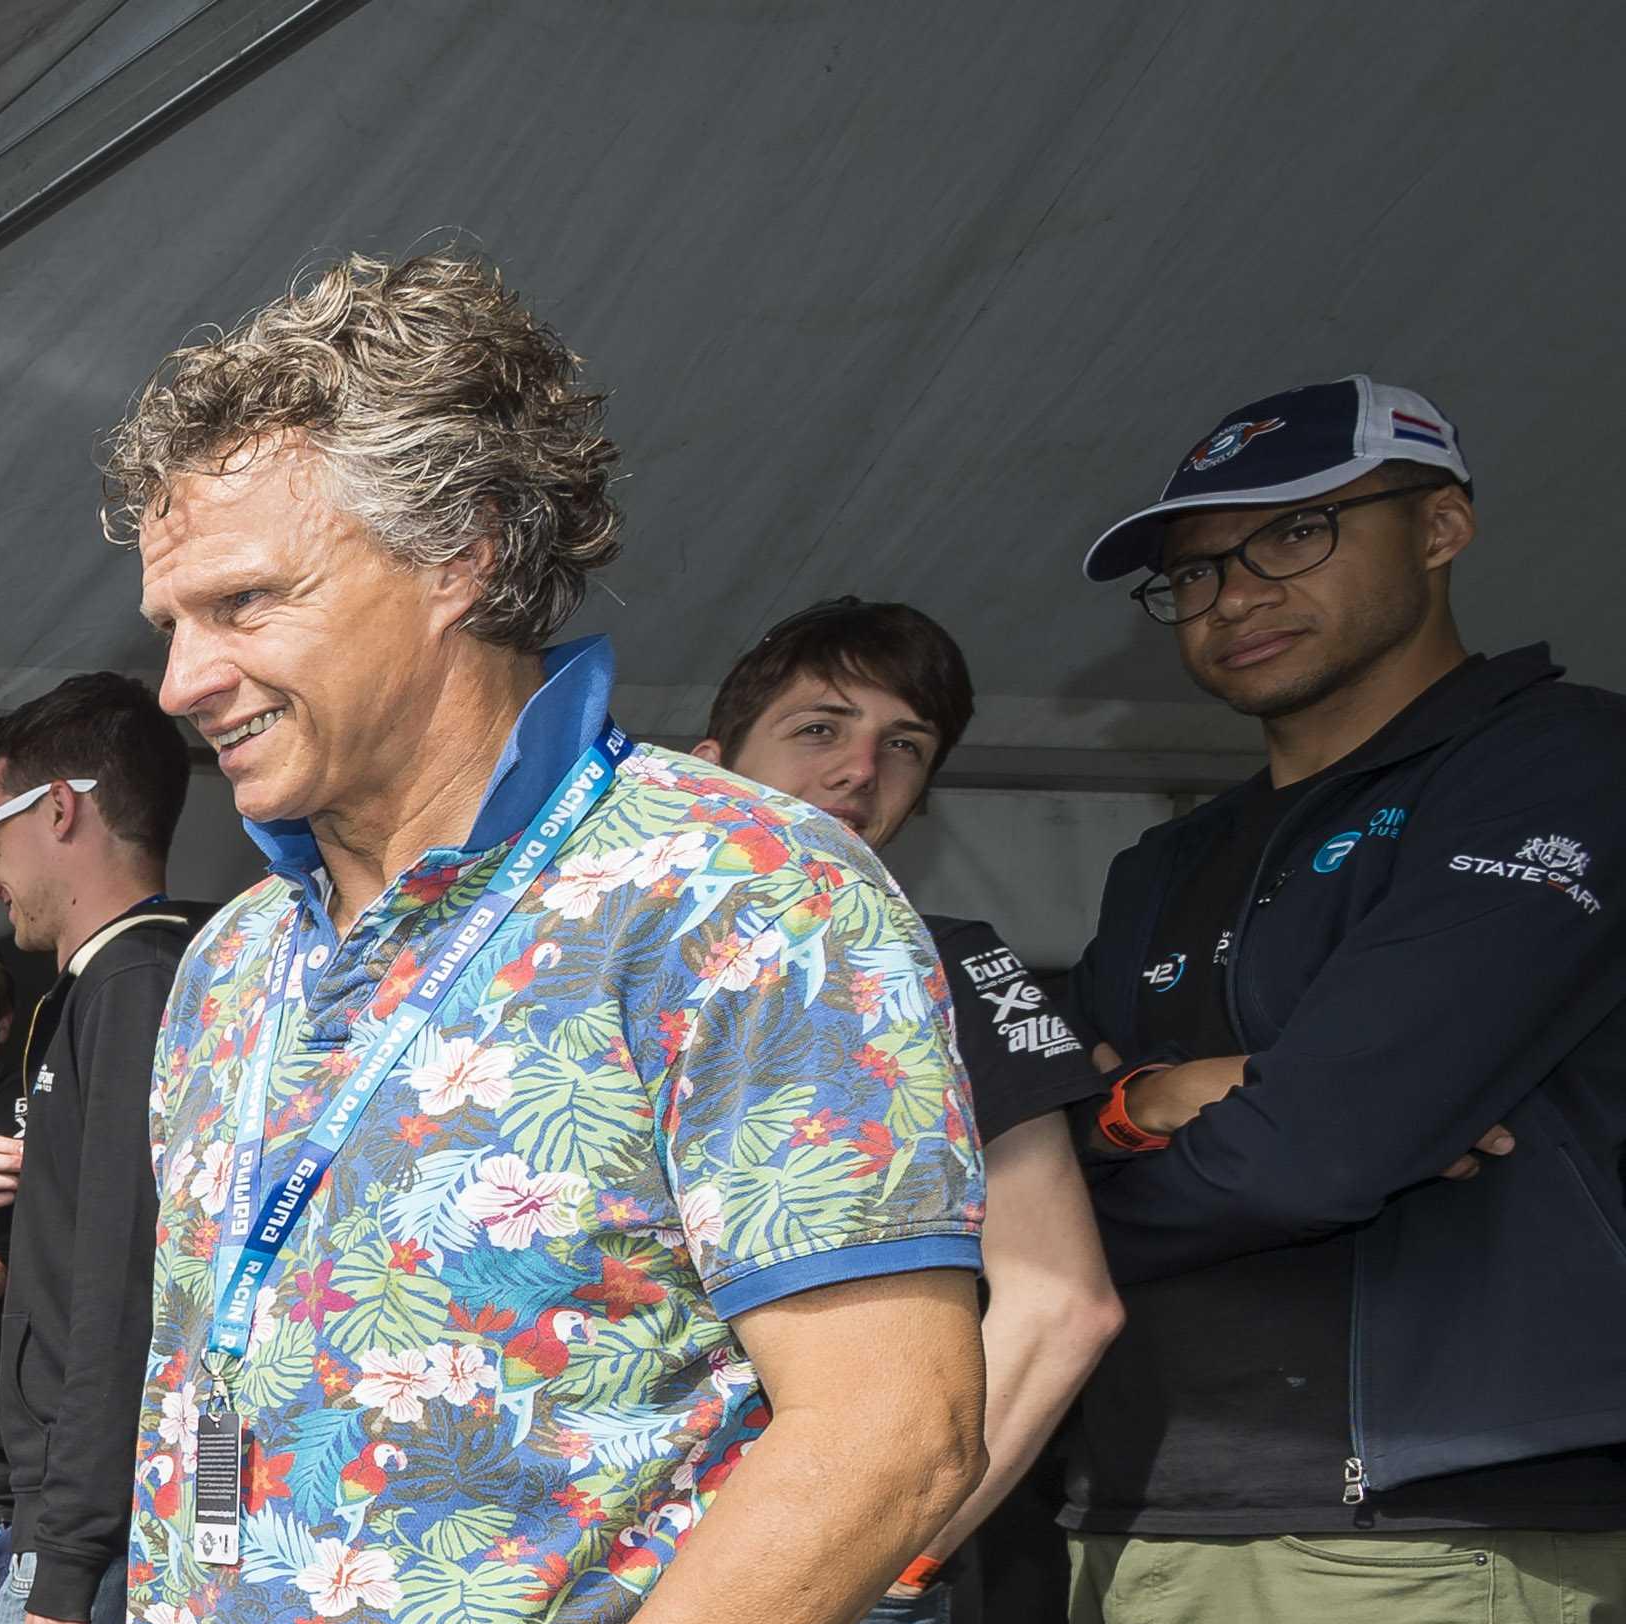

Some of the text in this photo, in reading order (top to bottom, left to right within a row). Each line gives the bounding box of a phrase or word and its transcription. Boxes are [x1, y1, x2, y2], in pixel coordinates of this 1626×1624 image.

[506, 760, 605, 886] RACING DAY
[1367, 825, 1399, 839] FUE
[1449, 855, 1601, 915] STATE OF ART
[325, 1010, 416, 1139] RACING DAY
[228, 1260, 263, 1323] RACIN
